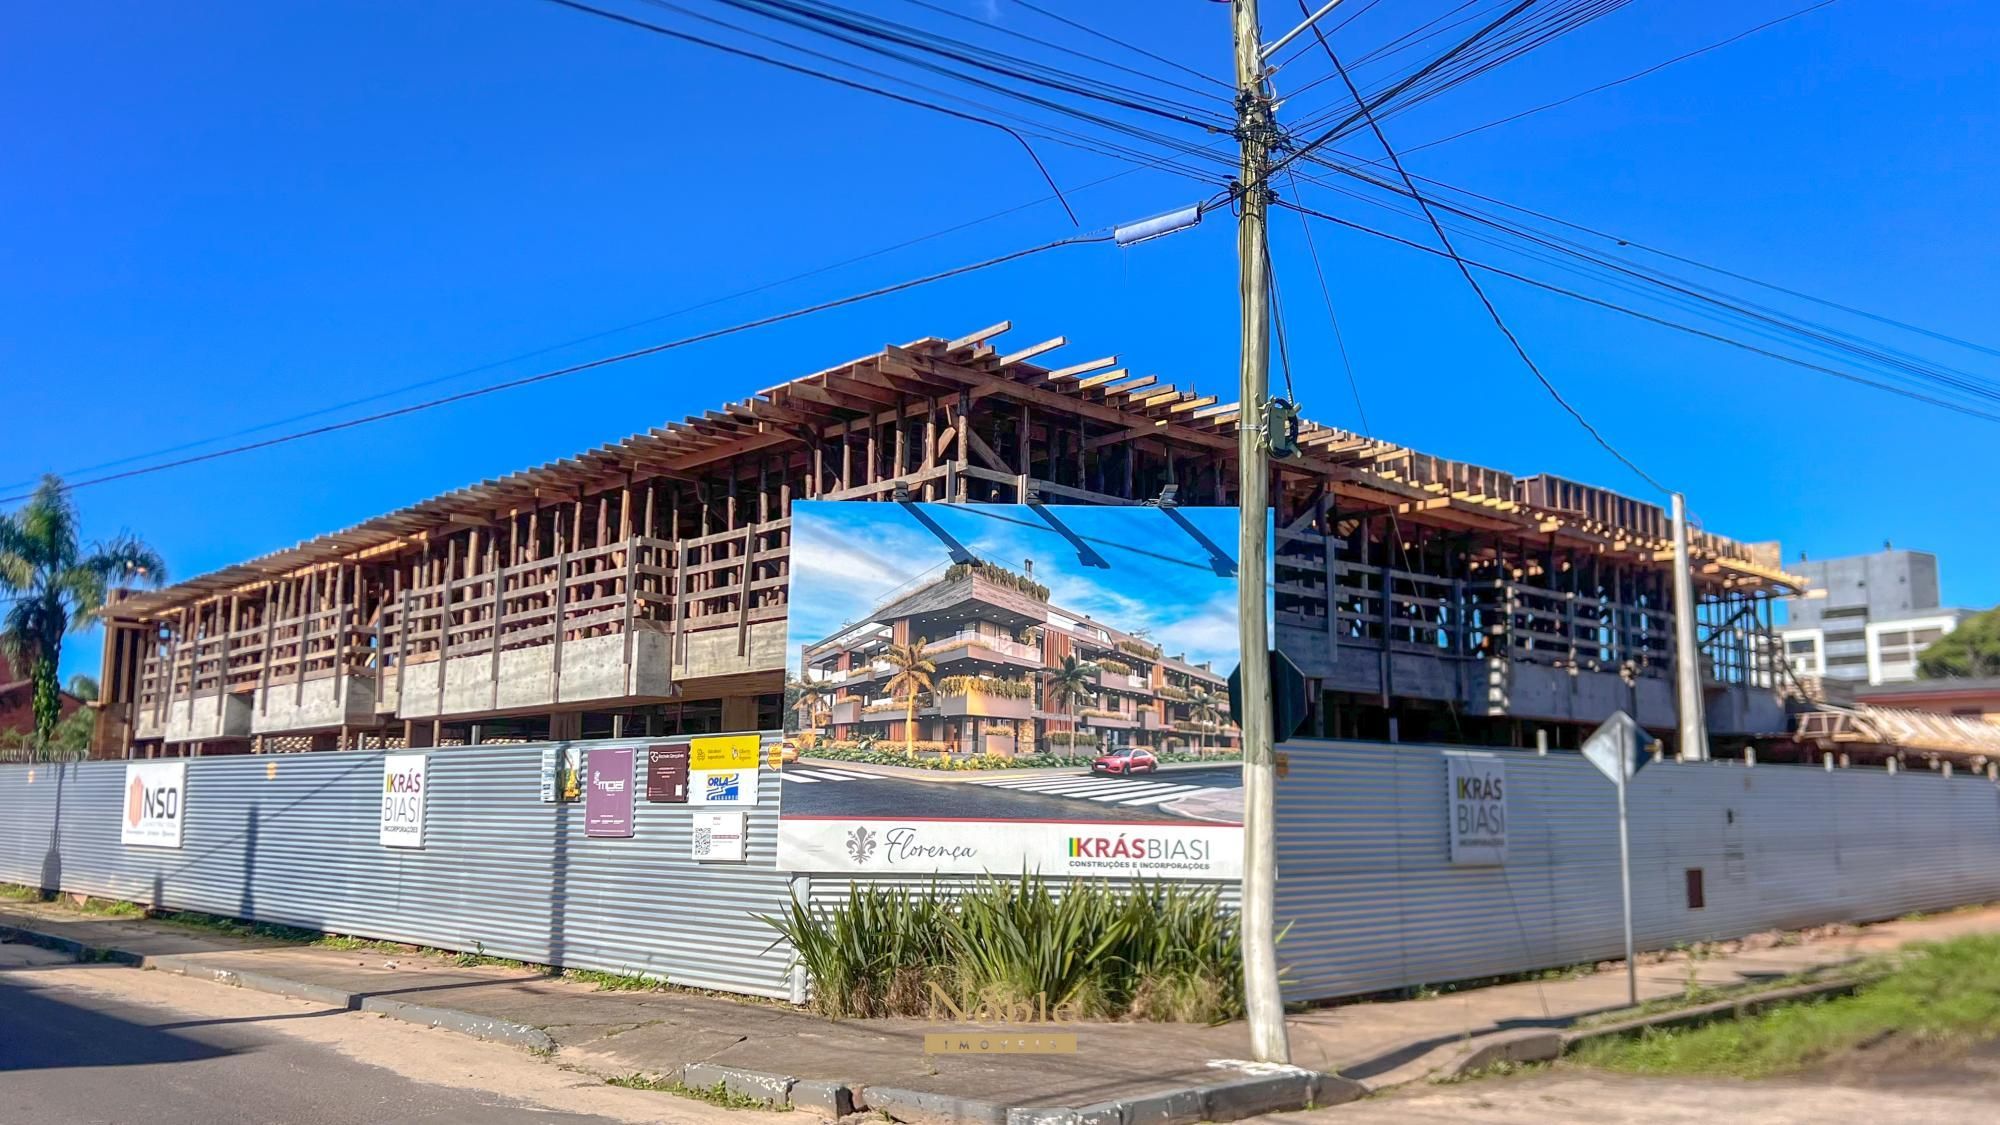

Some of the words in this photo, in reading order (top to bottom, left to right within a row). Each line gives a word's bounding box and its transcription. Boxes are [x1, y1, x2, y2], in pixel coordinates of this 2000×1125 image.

[708, 777, 729, 787] ORLA
[144, 787, 178, 819] NSO
[384, 796, 421, 823] BIASI
[1457, 804, 1504, 835] BIASI
[884, 827, 978, 864] Florença
[1069, 860, 1130, 869] CONSTRUÇÕES
[1140, 862, 1210, 871] INCORPORAÇÕES
